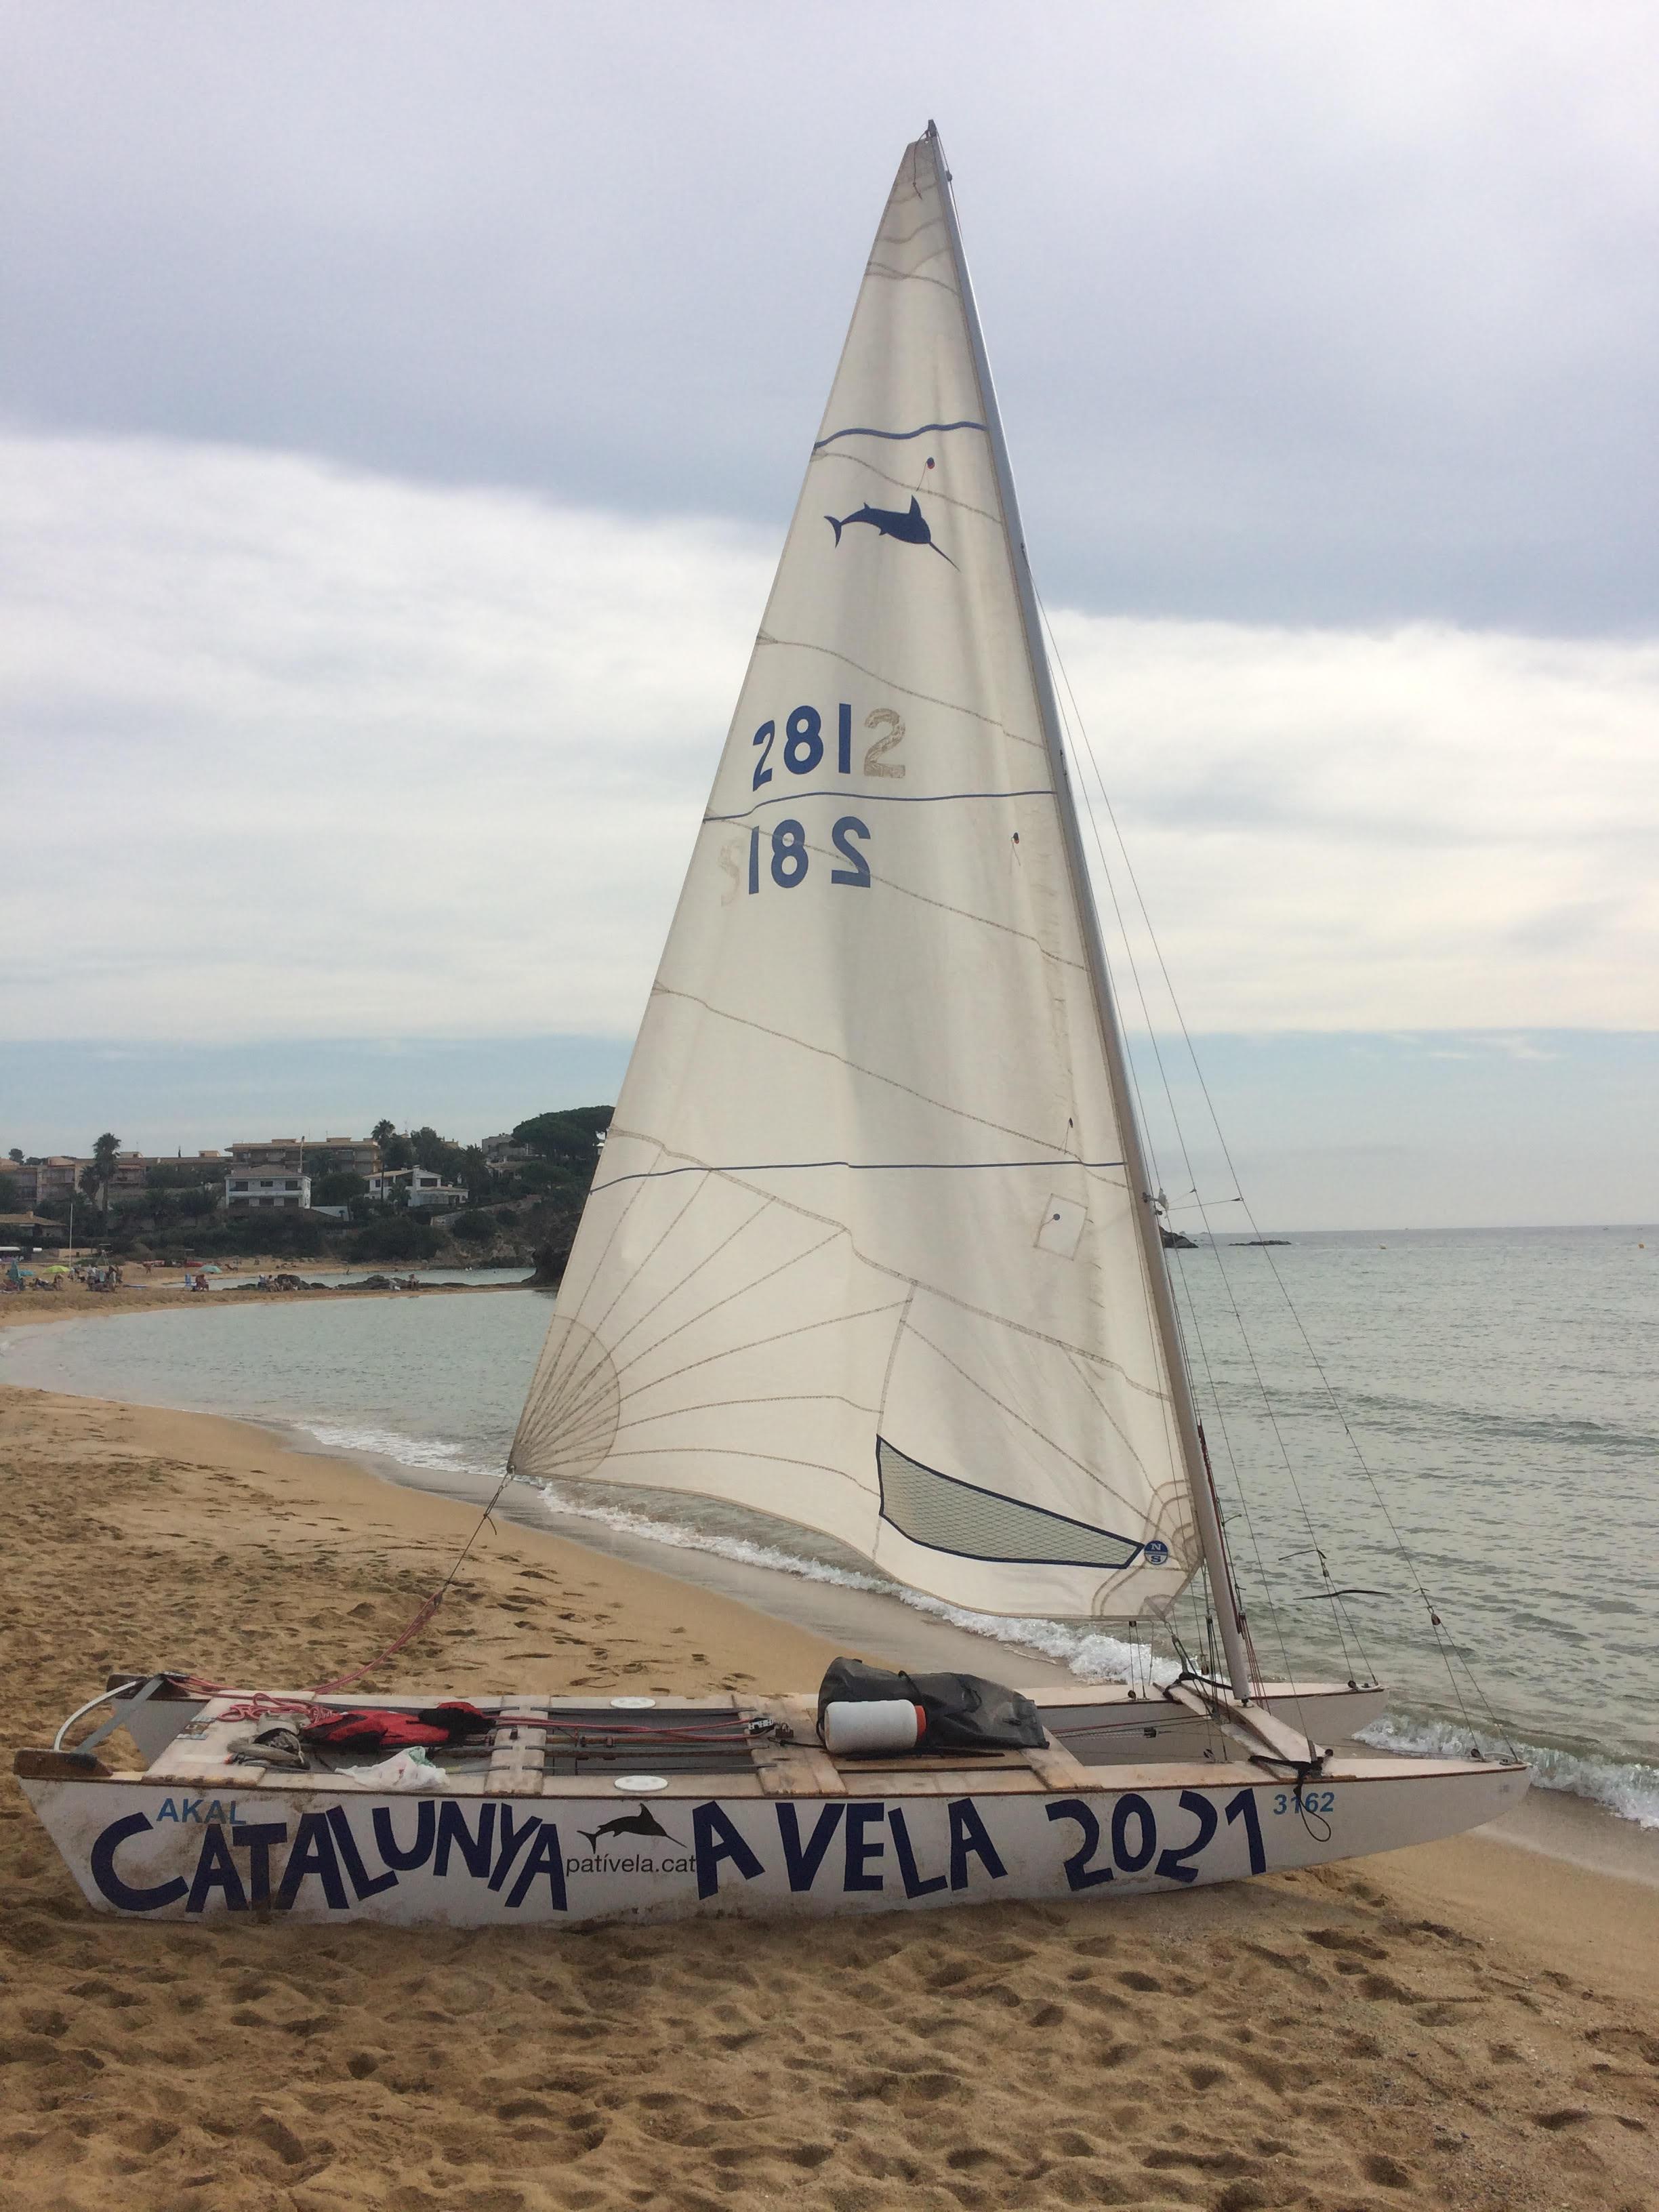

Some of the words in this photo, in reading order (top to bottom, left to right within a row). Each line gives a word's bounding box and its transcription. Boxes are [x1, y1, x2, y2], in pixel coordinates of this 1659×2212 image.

[157, 1798, 246, 1824] AKAL
[1273, 1791, 1334, 1815] 3162
[91, 1800, 568, 1912] CATALUNYA
[692, 1801, 764, 1900] A
[775, 1797, 1008, 1899] VELA
[1044, 1788, 1266, 1891] 2021
[567, 1853, 695, 1877] patívela.cat
